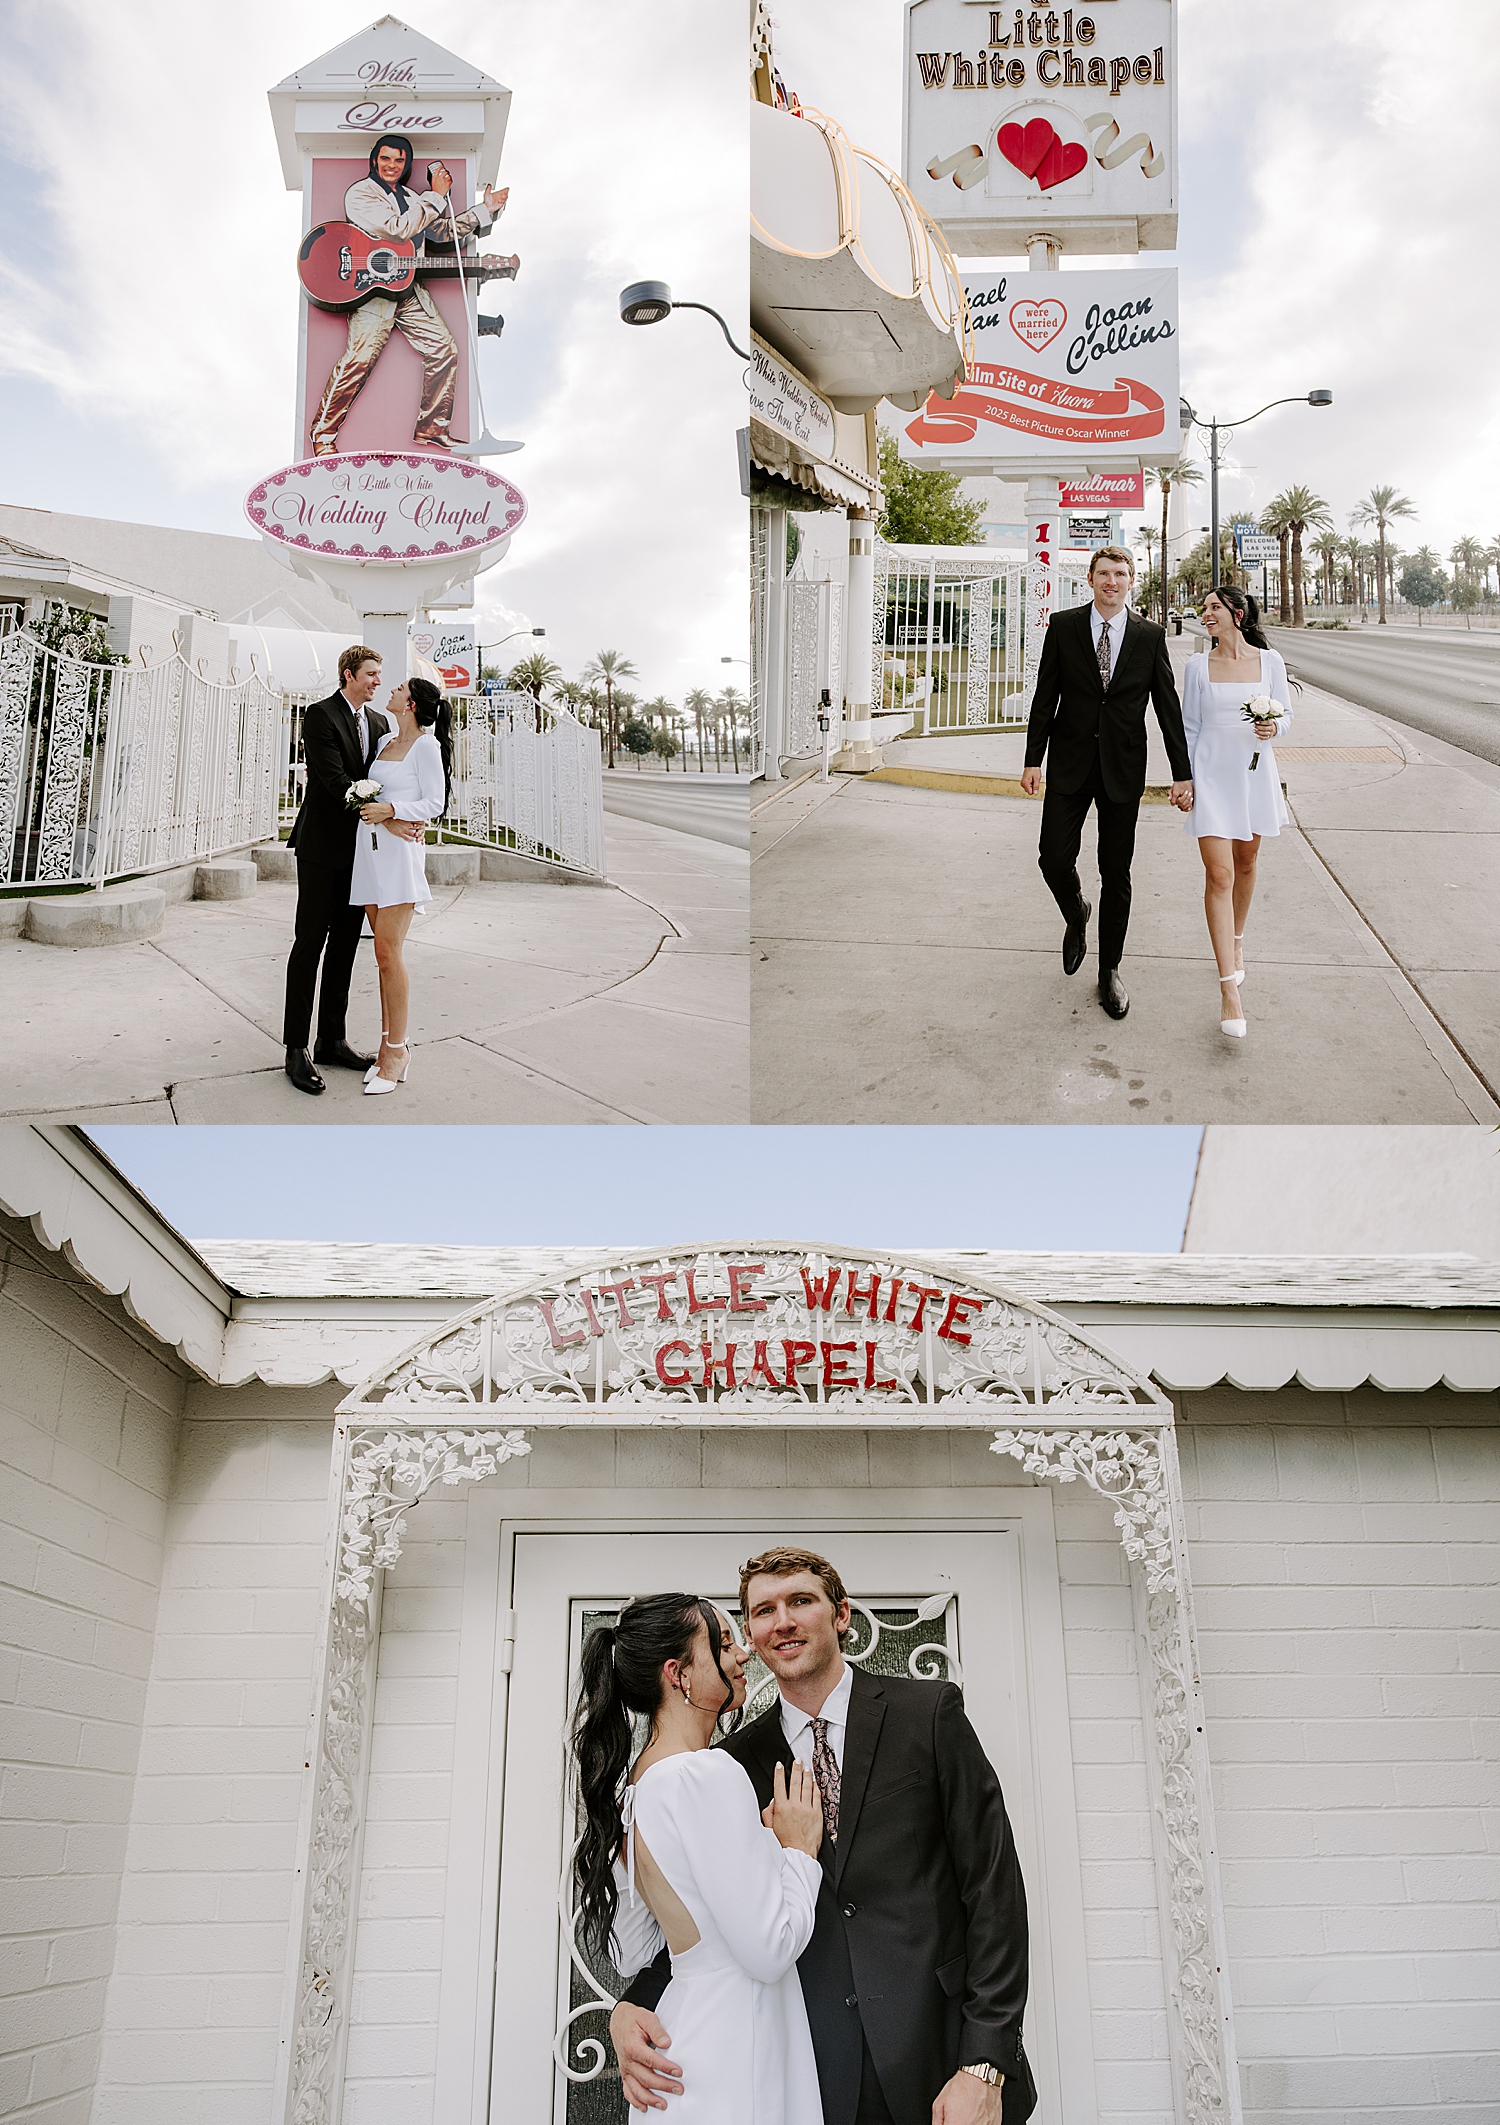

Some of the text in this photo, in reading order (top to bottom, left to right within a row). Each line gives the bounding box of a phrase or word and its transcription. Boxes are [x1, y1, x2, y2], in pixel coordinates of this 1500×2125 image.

[988, 9, 1096, 48] Little
[357, 58, 417, 83] With
[916, 46, 1165, 96] White Chapel
[337, 102, 444, 131] Love
[1017, 318, 1058, 328] married
[1025, 308, 1049, 318] were
[1085, 297, 1153, 345] Joan
[1026, 329, 1049, 339] here
[1066, 319, 1176, 375] Collins
[752, 349, 777, 387] White
[778, 371, 808, 417] Wedding
[996, 370, 1027, 392] Site
[1028, 382, 1048, 398] of
[750, 388, 765, 412] ive
[766, 397, 793, 431] Thru
[984, 404, 1130, 440] 2025 Best Picture Oscar Winner
[332, 473, 433, 492] A Little White
[1070, 494, 1110, 502] LAS VEGAS
[272, 491, 491, 535] Wedding Chapel
[433, 643, 473, 662] Collins
[440, 634, 466, 651] Joan
[538, 1264, 984, 1348] LITTLE WHITE
[655, 1339, 898, 1391] CHAPEL
